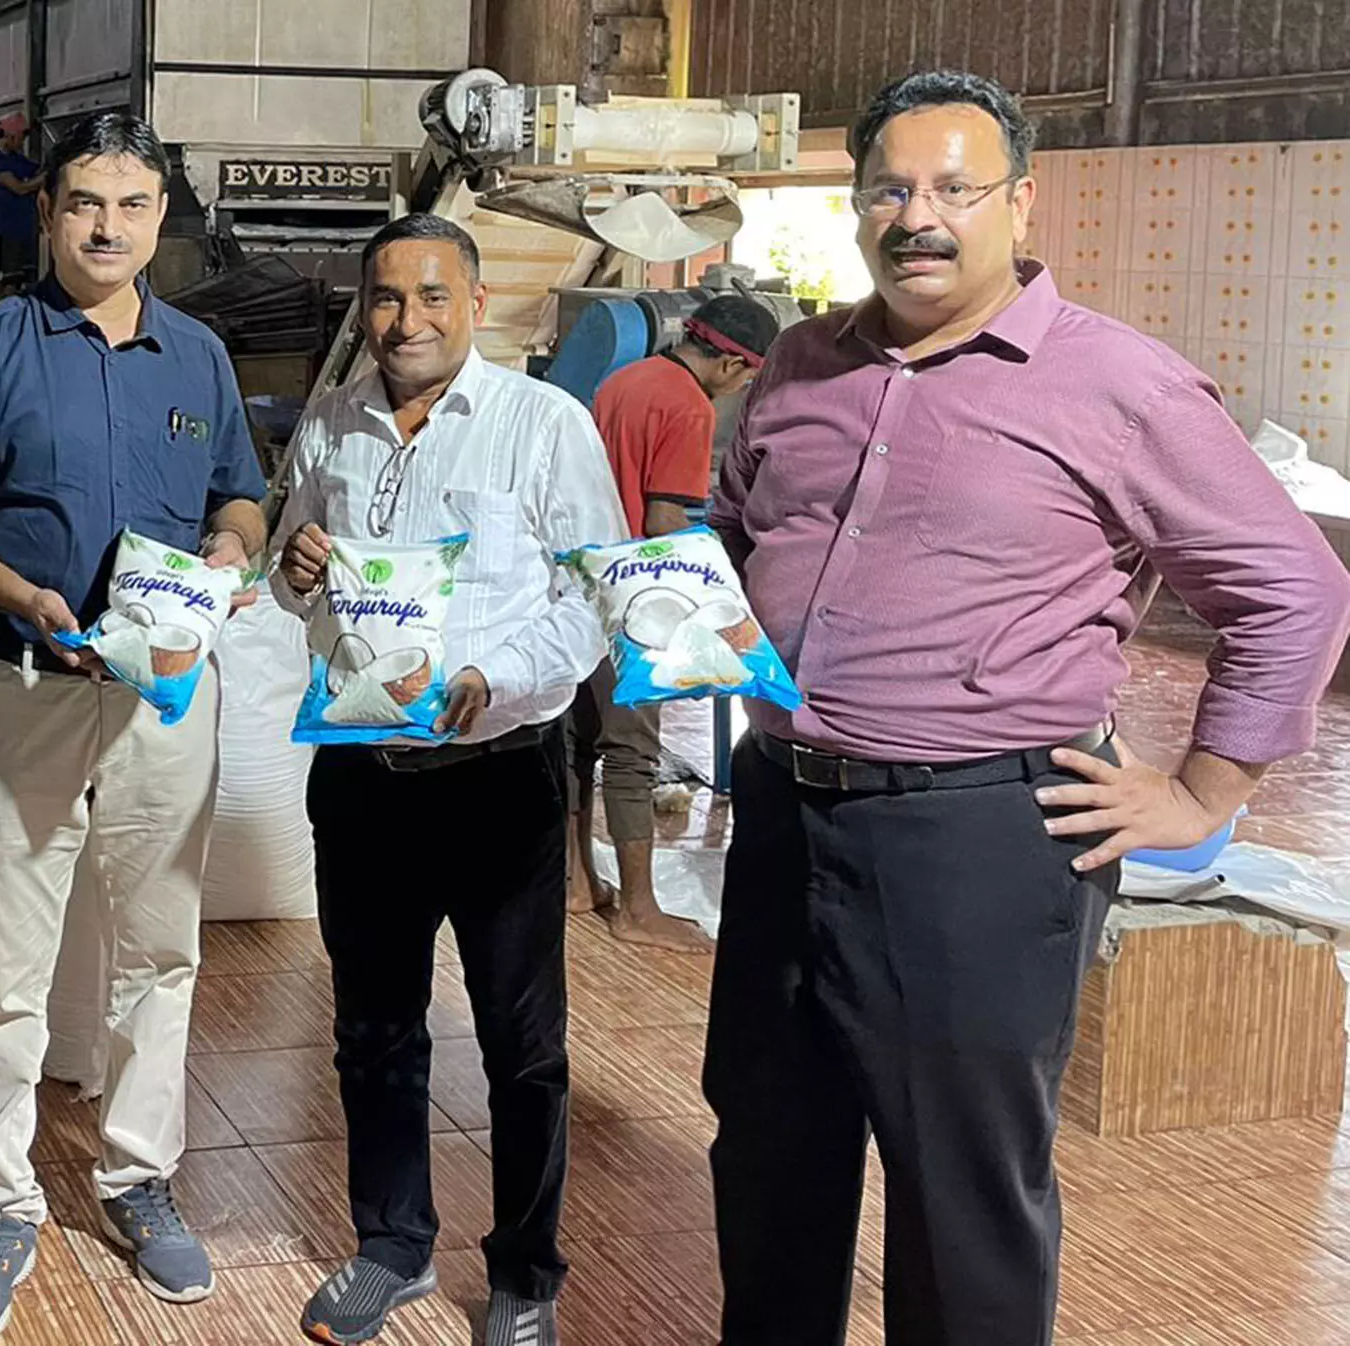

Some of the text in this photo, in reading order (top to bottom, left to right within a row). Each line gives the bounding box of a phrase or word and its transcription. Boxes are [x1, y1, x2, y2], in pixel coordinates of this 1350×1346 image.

[225, 164, 391, 187] EVEREST
[600, 557, 725, 585] Tenguraja
[116, 570, 216, 611] Tenguraja
[326, 589, 427, 627] Tenguraja
